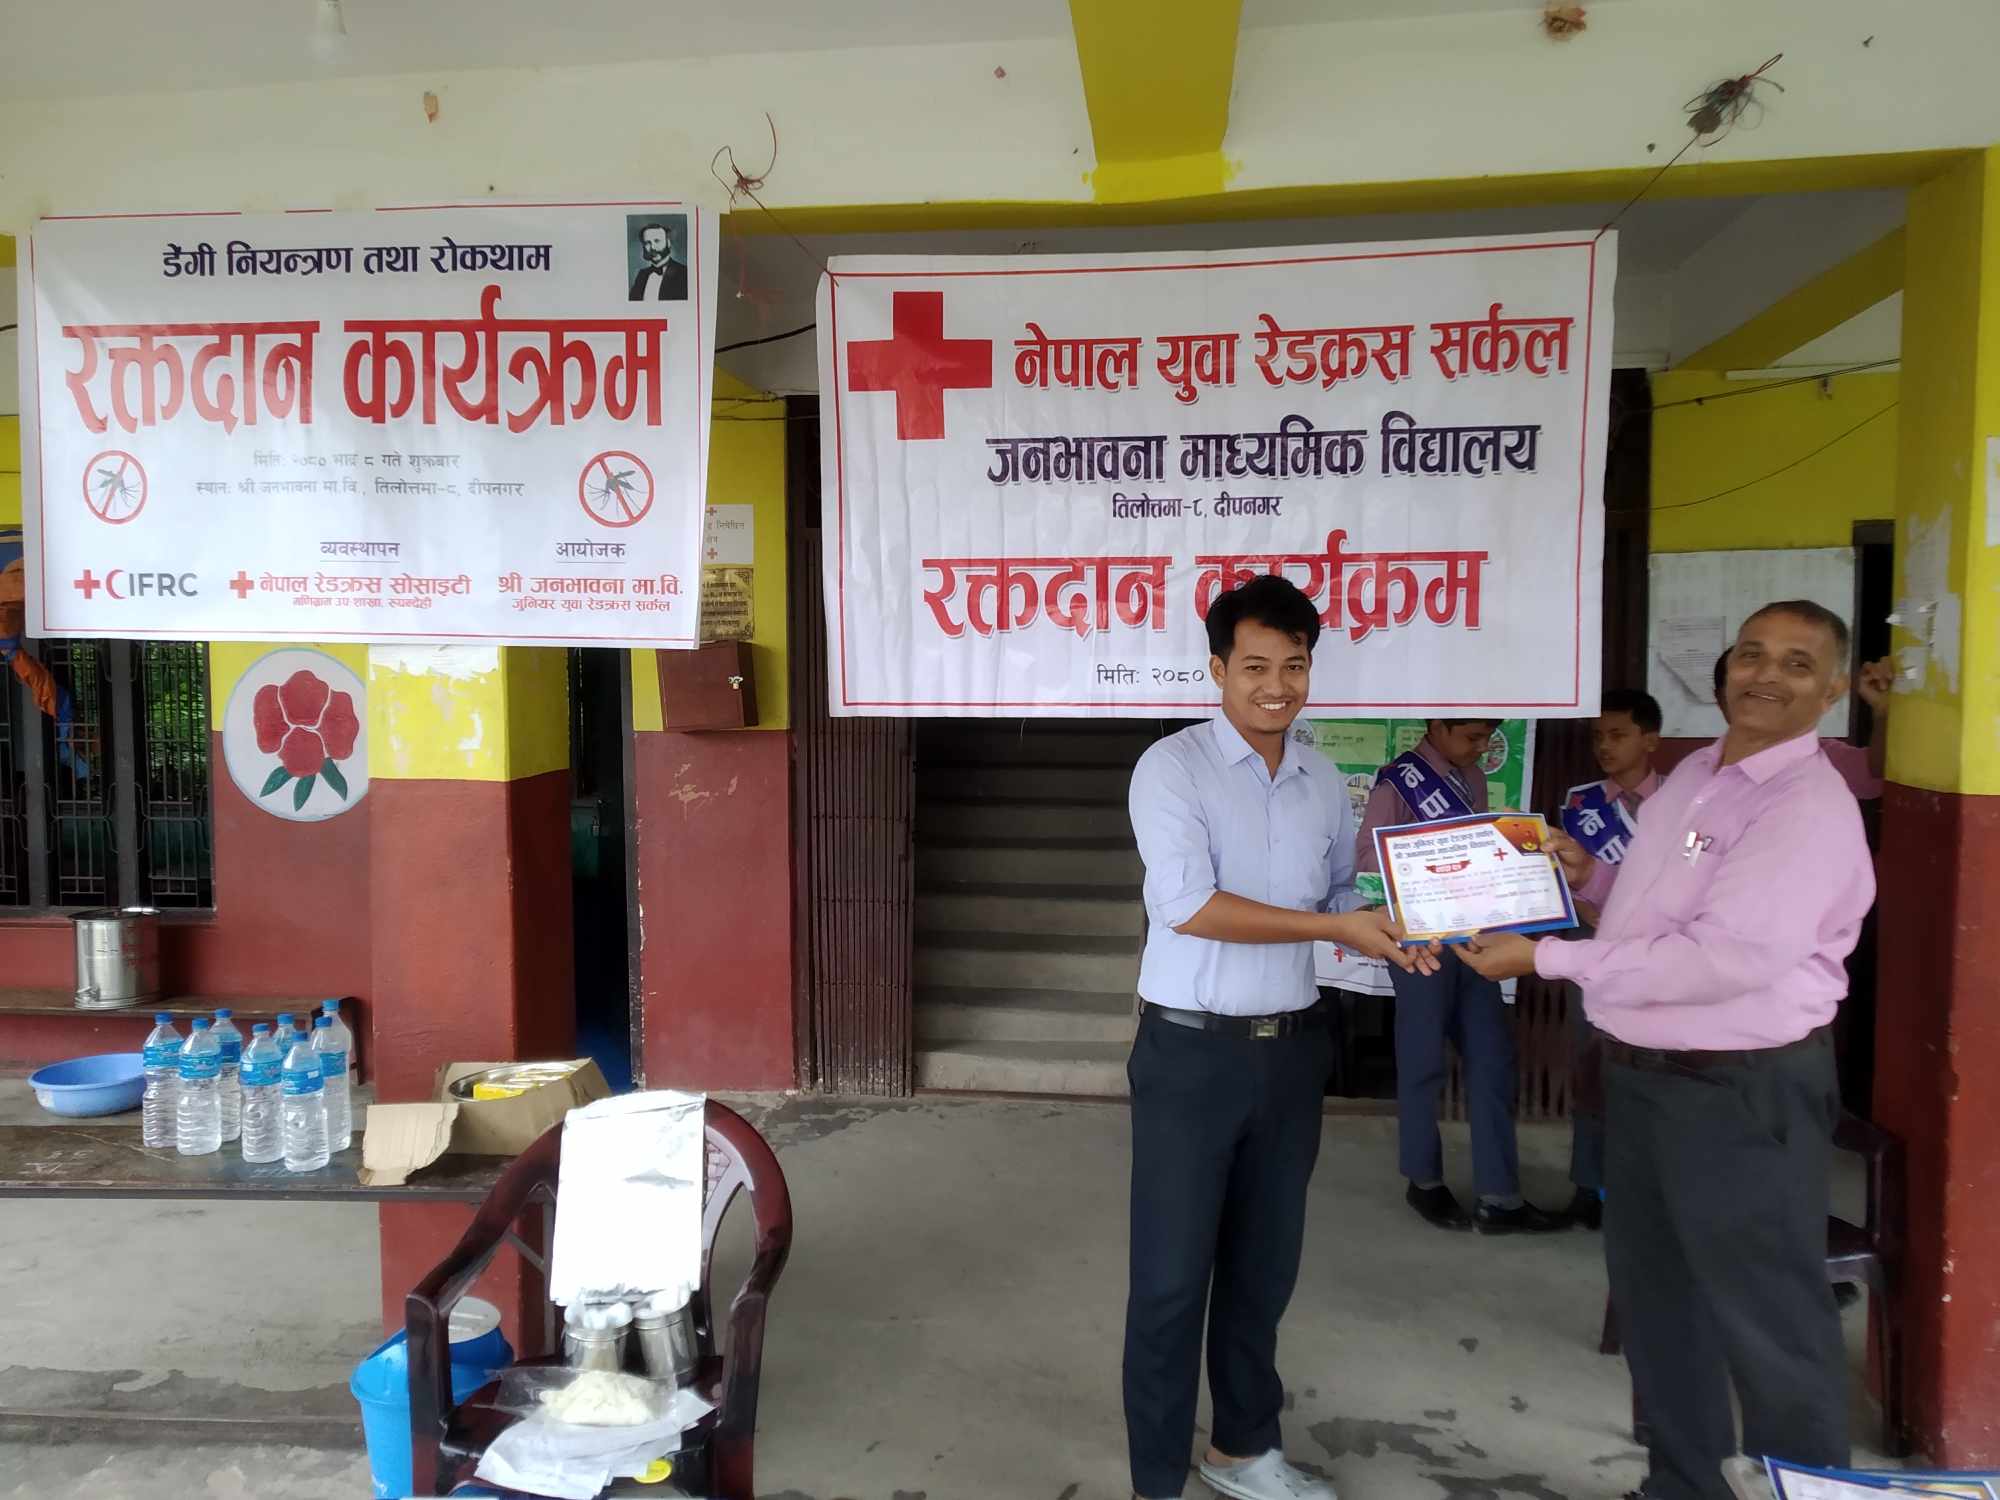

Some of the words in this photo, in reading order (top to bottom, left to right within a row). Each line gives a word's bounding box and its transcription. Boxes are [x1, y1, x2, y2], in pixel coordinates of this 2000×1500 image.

[227, 241, 353, 276] नियन्त्रण
[364, 245, 419, 273] तथा
[431, 237, 552, 273] रोकथाम
[62, 320, 320, 435] रक्तदान
[343, 285, 668, 435] कार्यक्रम
[1014, 322, 1143, 391] नेपाल
[1157, 333, 1239, 402] युवा
[1254, 313, 1415, 390] रेडक्रस
[1430, 303, 1575, 380] सर्कल
[364, 456, 375, 466] ८
[382, 450, 403, 467] गते
[985, 435, 1168, 484] जनभावना
[1180, 414, 1368, 479] माध्यमिक
[1381, 411, 1542, 475] विद्यालय
[238, 478, 255, 495] श्री
[259, 480, 318, 494] जनभावना
[468, 477, 525, 496] दीपनगर
[1213, 492, 1284, 518] दीपनगर
[319, 541, 400, 557] व्यवस्थापन
[555, 538, 627, 558] आयोजक
[128, 573, 198, 597] IFRC
[260, 572, 308, 593] नेपाल
[314, 572, 384, 594] रेडक्रस
[389, 573, 472, 596] सोसाइटी
[498, 571, 523, 594] श्री
[530, 577, 625, 595] जनभावना
[512, 596, 555, 612] जुनियर
[561, 598, 583, 612] युवा
[587, 597, 631, 612] रेडक्रस
[635, 598, 671, 612] सर्कल
[922, 555, 1173, 638] रक्तदान
[1097, 663, 1140, 685] मिति:
[1152, 667, 1205, 686] २०८०
